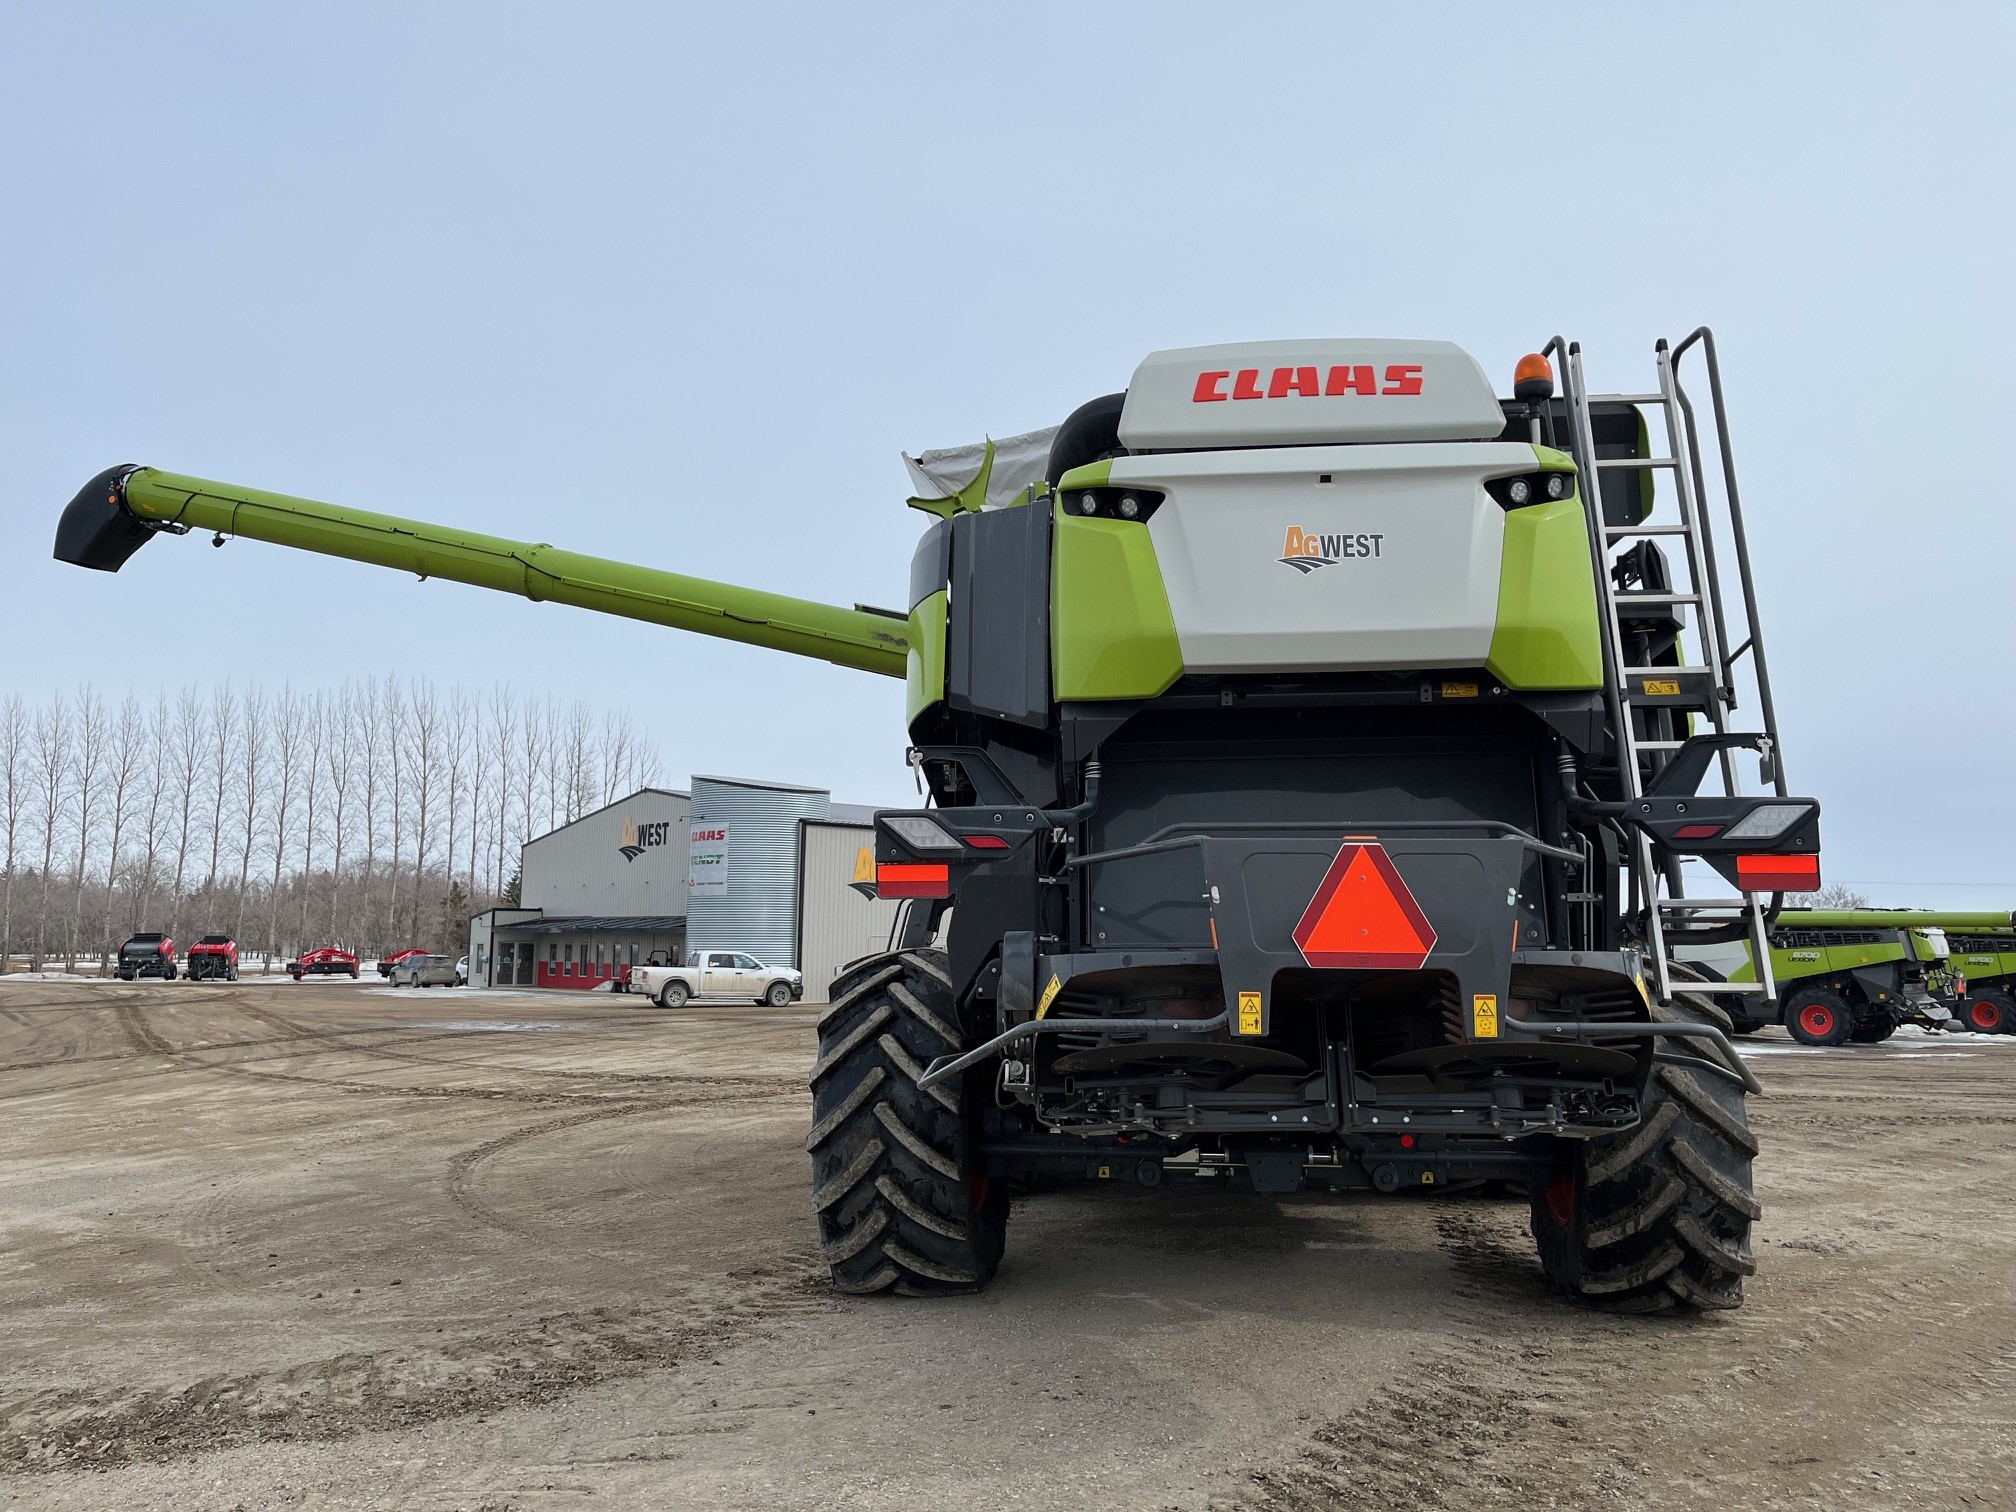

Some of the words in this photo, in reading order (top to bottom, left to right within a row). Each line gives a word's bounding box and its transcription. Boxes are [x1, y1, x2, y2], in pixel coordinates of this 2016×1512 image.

[1193, 365, 1423, 402] CLAAS
[1283, 525, 1384, 558] AGWEST
[691, 830, 726, 842] CLAAS
[690, 854, 724, 866] FENDT
